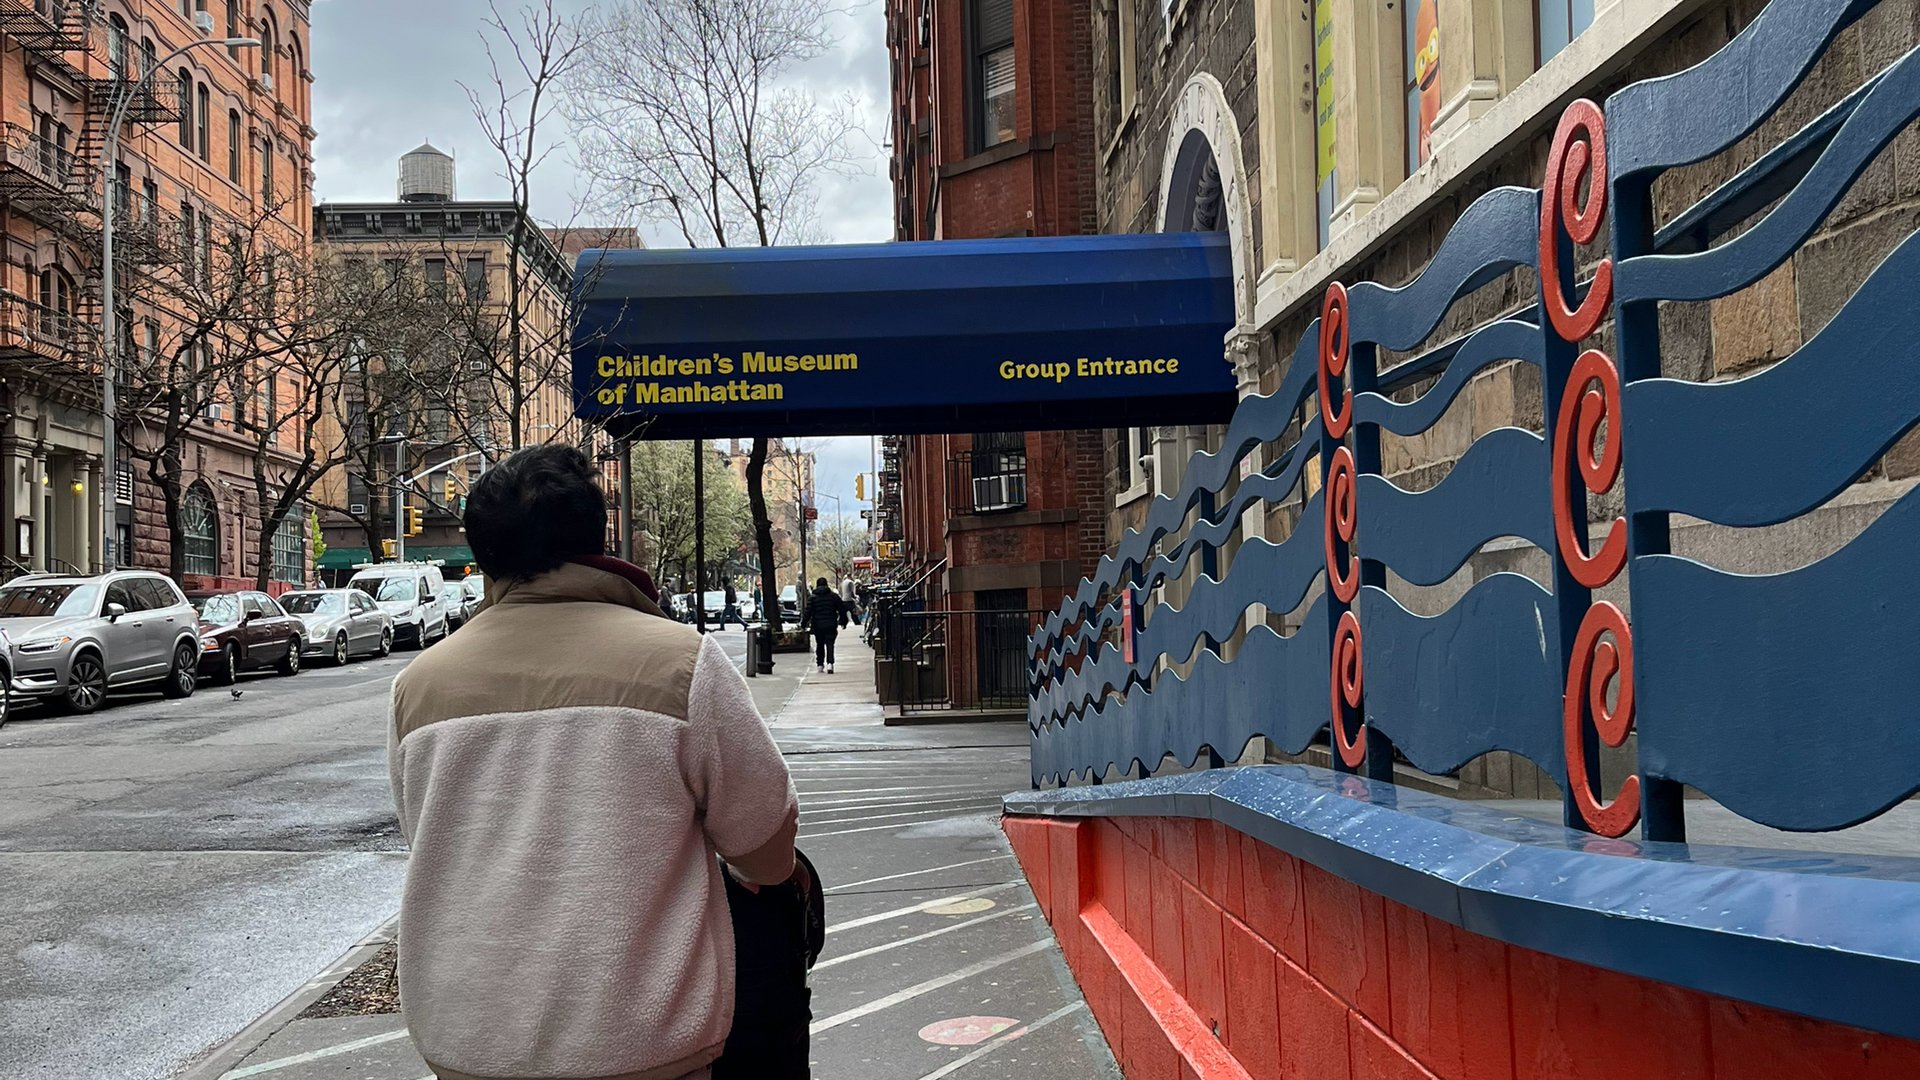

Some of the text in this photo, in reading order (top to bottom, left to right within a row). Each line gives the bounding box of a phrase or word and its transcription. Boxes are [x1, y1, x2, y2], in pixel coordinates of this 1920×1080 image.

[742, 352, 858, 373] Museum
[1000, 357, 1179, 383] Group Entrance
[597, 380, 784, 405] of Manhattan
